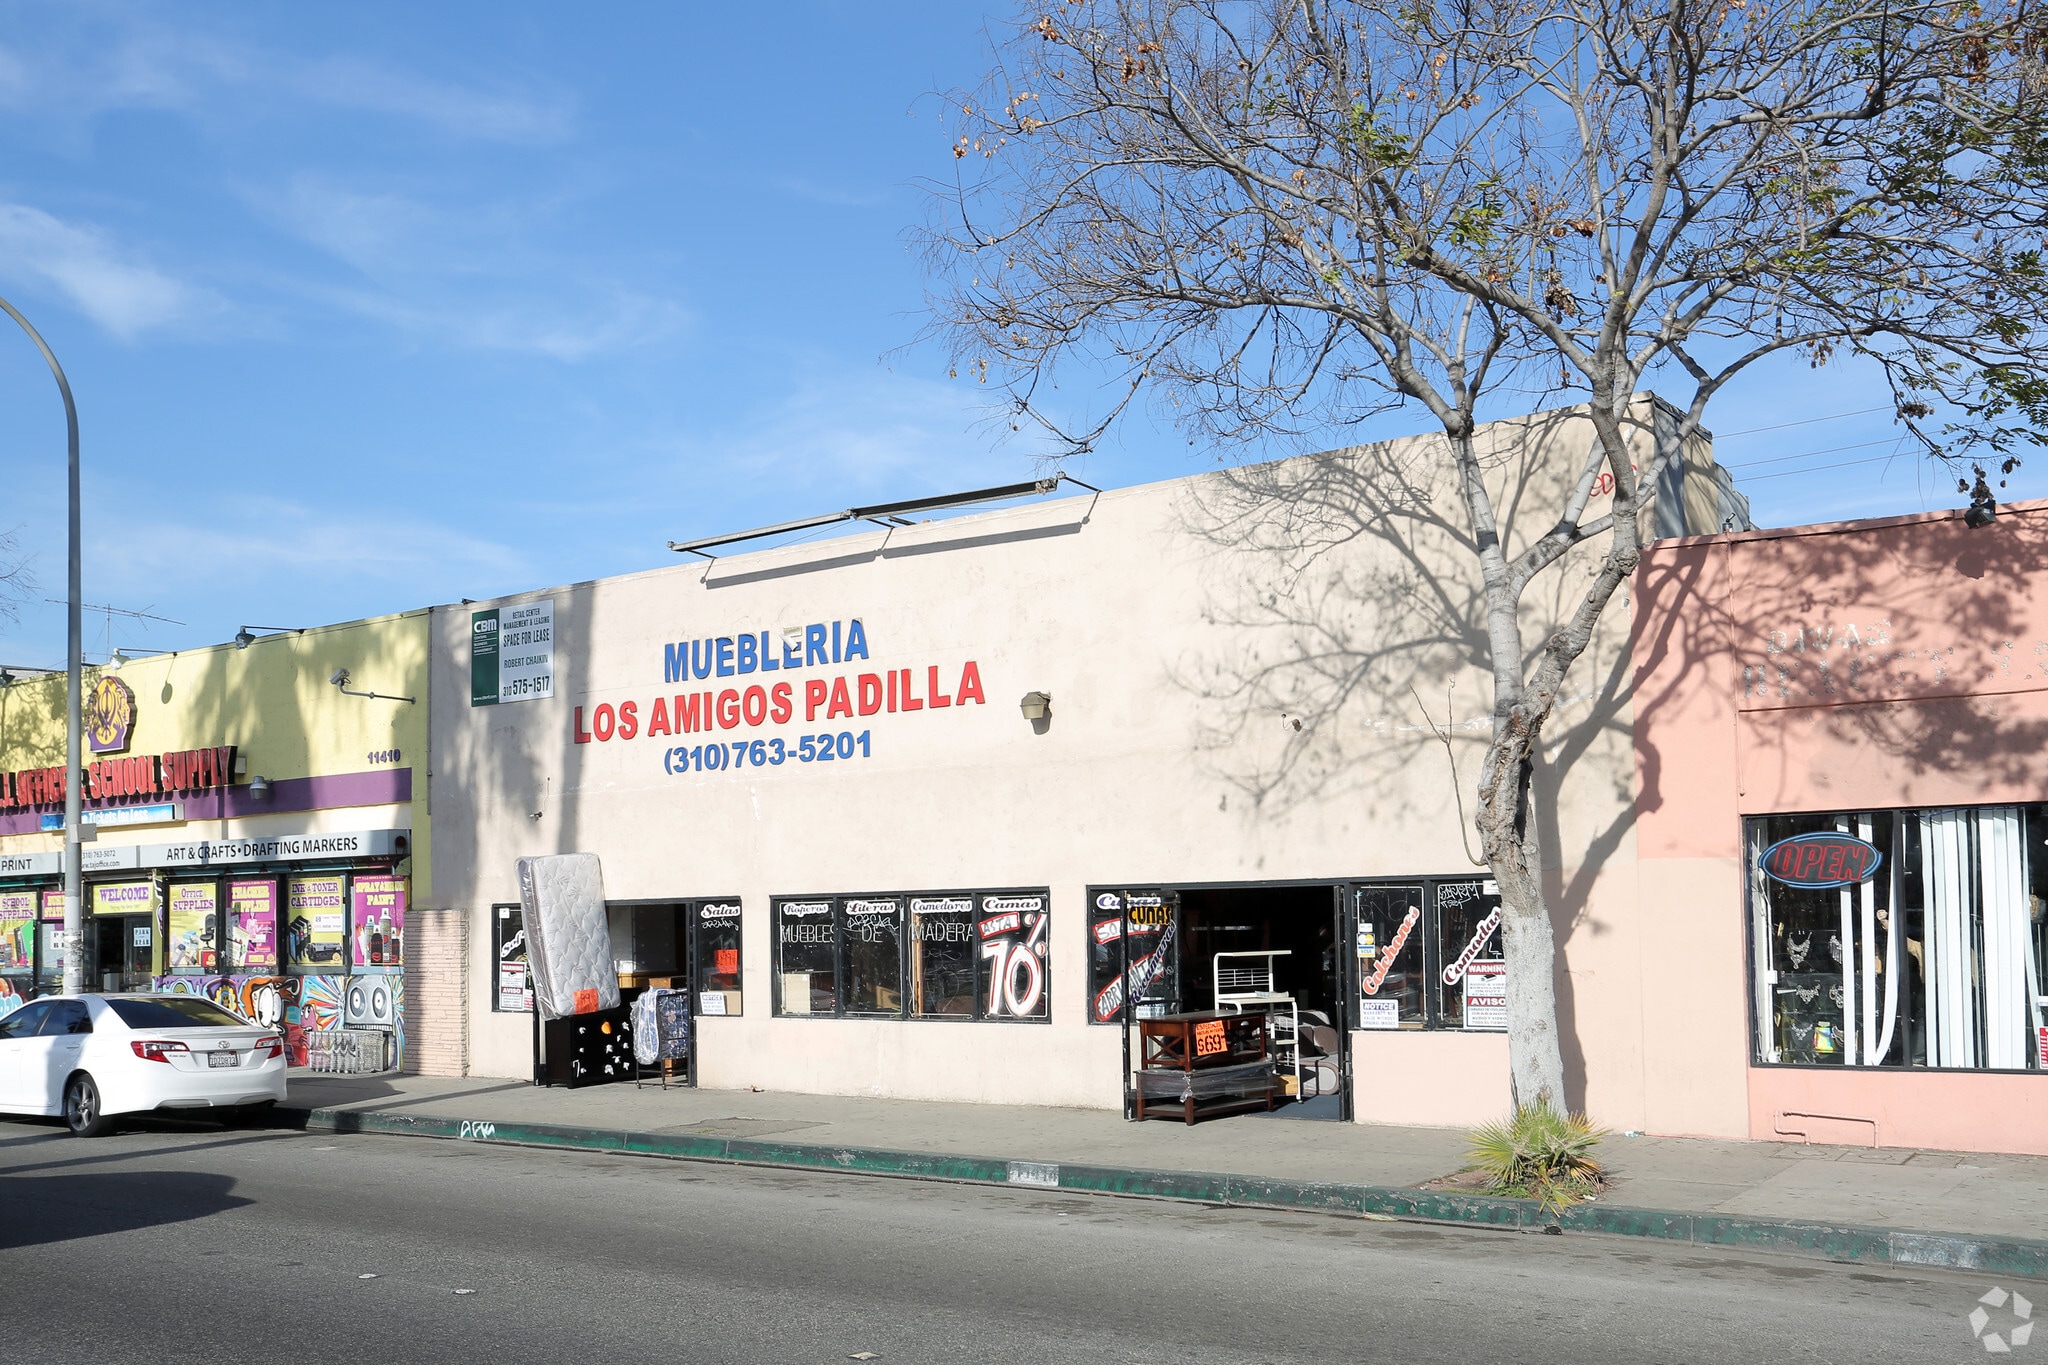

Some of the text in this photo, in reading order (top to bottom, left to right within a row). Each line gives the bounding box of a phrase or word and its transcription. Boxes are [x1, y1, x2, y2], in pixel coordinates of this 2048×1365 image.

[512, 608, 540, 619] RETAIL CENTER
[503, 619, 529, 630] MANAGEMENT
[533, 616, 550, 625] LEASING
[503, 629, 550, 647] SPACE FOR LEASE
[664, 617, 869, 684] MUEBLERIA
[504, 657, 525, 668] ROBERT
[503, 675, 550, 697] 310 575-1517
[574, 661, 986, 744] LOS AMIGOS PADILLA
[367, 748, 401, 764] 11410
[664, 729, 871, 775] (310)763-5201
[89, 755, 157, 799] SCHOOL
[162, 745, 233, 792] SUPPLY
[89, 811, 117, 824] Tickets
[130, 808, 149, 822] Less
[166, 836, 358, 861] ART & CRAFTS DRAFTING MARKERS
[1, 858, 32, 871] PRINT
[1773, 843, 1868, 881] OPEN
[99, 886, 149, 902] WELCOME
[291, 883, 305, 893] INK
[312, 882, 339, 892] TONER
[2, 896, 30, 907] SCHOOL
[173, 899, 214, 911] SUPPLIES
[848, 902, 895, 913] Literas
[912, 899, 971, 912] Comedores
[984, 898, 1040, 910] Camas
[702, 905, 740, 917] Salas
[784, 904, 828, 916] Roperos
[1129, 906, 1172, 926] CUNAS
[983, 916, 1012, 934] ASTA
[1363, 906, 1420, 995] Colchones
[1471, 997, 1506, 1006] AVISO
